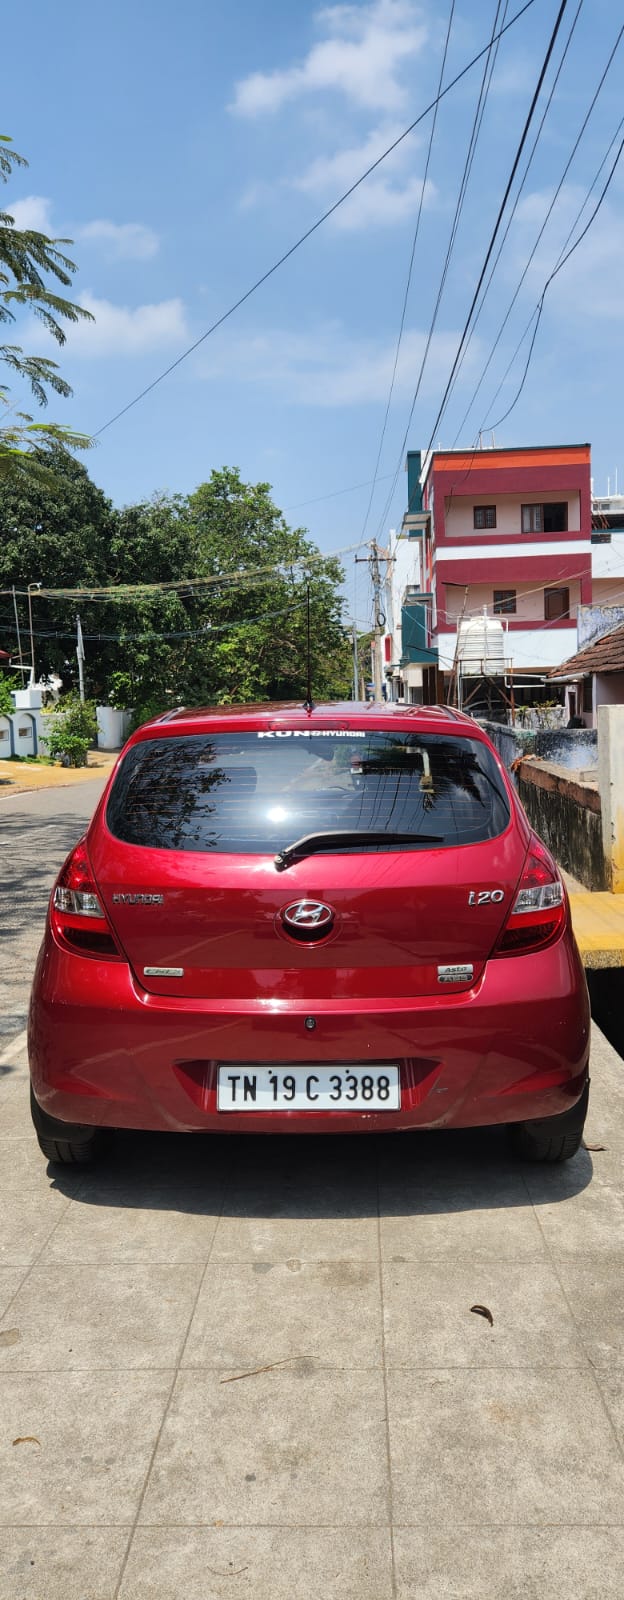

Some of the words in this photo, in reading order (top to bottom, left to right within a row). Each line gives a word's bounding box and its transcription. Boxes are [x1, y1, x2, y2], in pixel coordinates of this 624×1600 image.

[257, 730, 309, 738] KUN
[112, 893, 164, 904] HYUNDAI
[468, 889, 505, 906] i20
[227, 1075, 257, 1102] TN
[269, 1075, 296, 1102] 19
[306, 1075, 320, 1101] C
[329, 1075, 391, 1101] 3388
